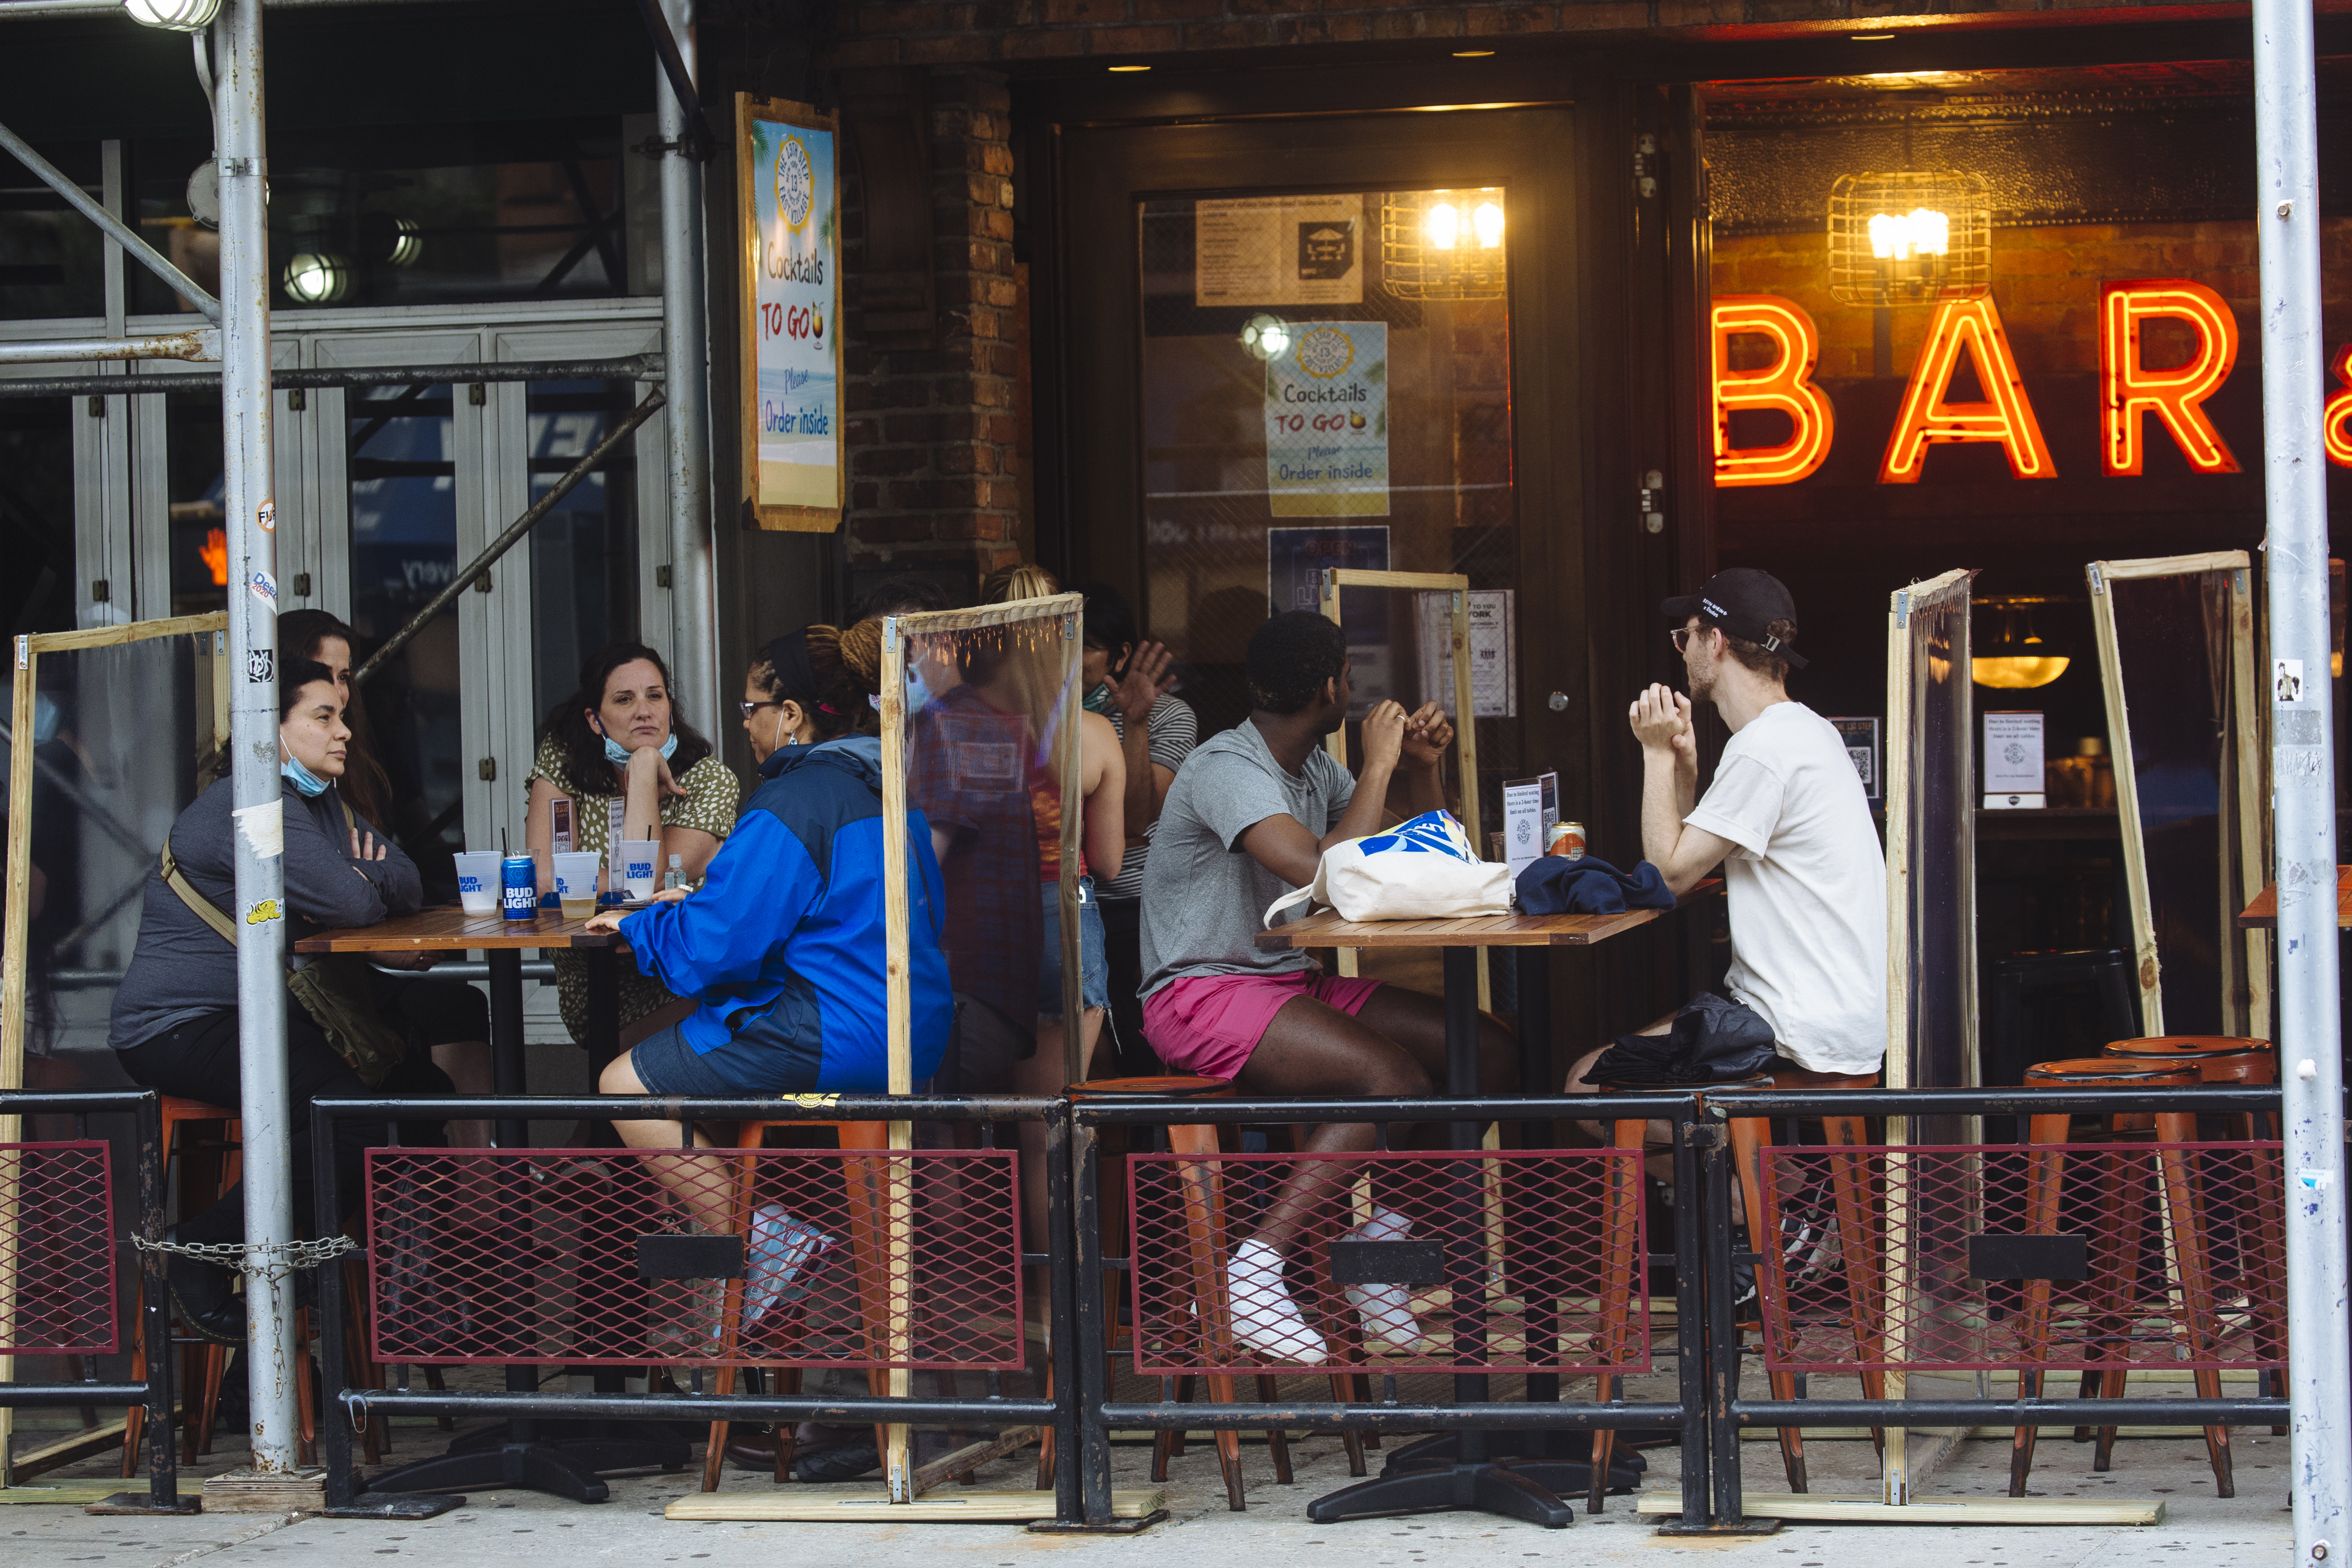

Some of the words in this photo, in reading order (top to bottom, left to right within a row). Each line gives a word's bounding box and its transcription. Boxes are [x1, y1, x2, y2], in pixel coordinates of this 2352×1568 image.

[779, 153, 787, 177] THE
[786, 142, 798, 159] 13TH
[798, 151, 809, 180] STEP
[791, 174, 798, 192] 13
[779, 186, 791, 216] EAST
[791, 190, 810, 224] VILLAGE
[767, 240, 823, 285] Cocktails
[761, 302, 783, 341] TO
[787, 305, 810, 341] GO
[784, 366, 808, 395] Please
[1712, 278, 2243, 487] BAR
[1284, 382, 1367, 403] Cocktails
[766, 400, 796, 433] Order
[800, 403, 828, 435] inside
[1274, 414, 1304, 434] TO
[1312, 413, 1345, 433] GO
[1307, 445, 1342, 460] Please
[1279, 463, 1322, 481] Order
[1328, 461, 1372, 479] inside
[252, 583, 269, 598] 2020
[1858, 722, 1872, 730] STEP
[627, 871, 653, 879] LIGHT
[630, 862, 651, 871] BUD
[506, 887, 533, 898] BUD
[503, 897, 537, 909] LIGHT
[796, 1095, 823, 1106] BORUSSIA
